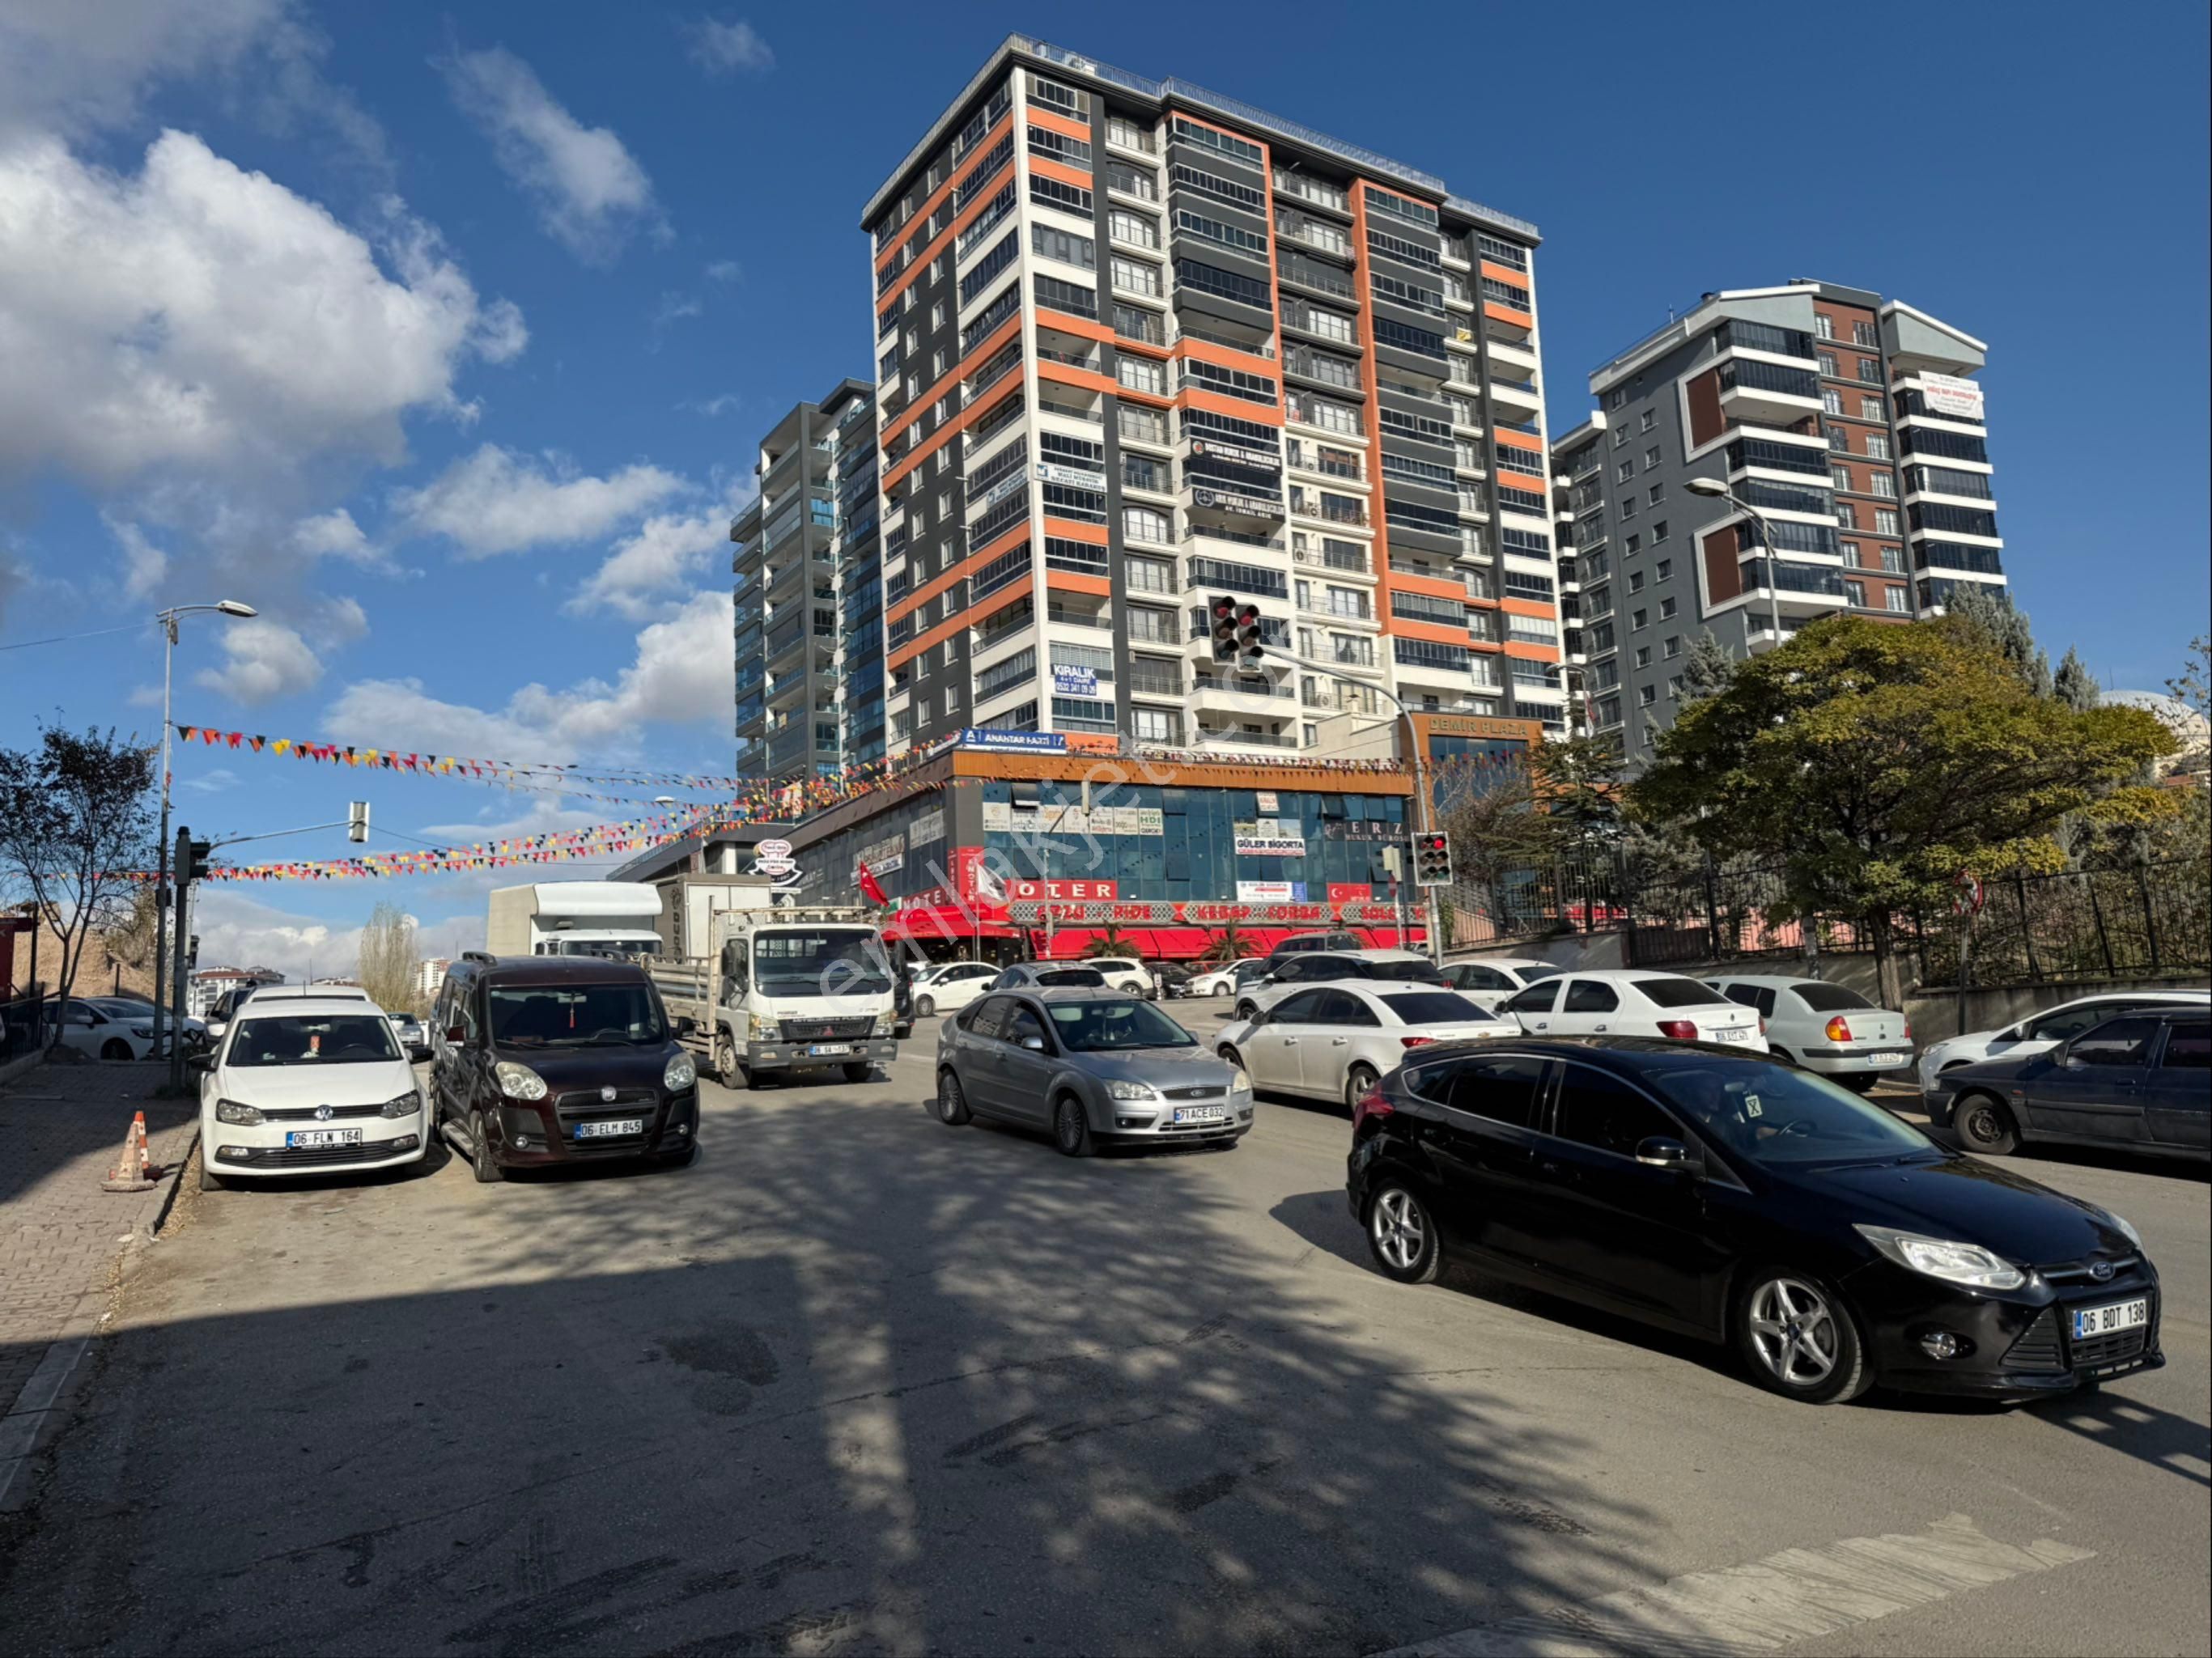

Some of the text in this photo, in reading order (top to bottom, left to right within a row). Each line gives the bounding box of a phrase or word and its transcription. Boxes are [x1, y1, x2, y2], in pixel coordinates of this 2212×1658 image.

[1481, 723, 1528, 736] PLAZA
[985, 733, 1025, 744] ANAHTAR
[1237, 838, 1304, 849] GÜLER SİGORTA
[1017, 883, 1112, 898] OTER
[1180, 1106, 1224, 1119] 71 ACE 032
[582, 1121, 641, 1136] 06 ELM 845
[294, 1134, 308, 1145] 06
[313, 1132, 333, 1143] FLN
[342, 1130, 359, 1142] 164
[2083, 1301, 2145, 1333] 06 BDT 138
